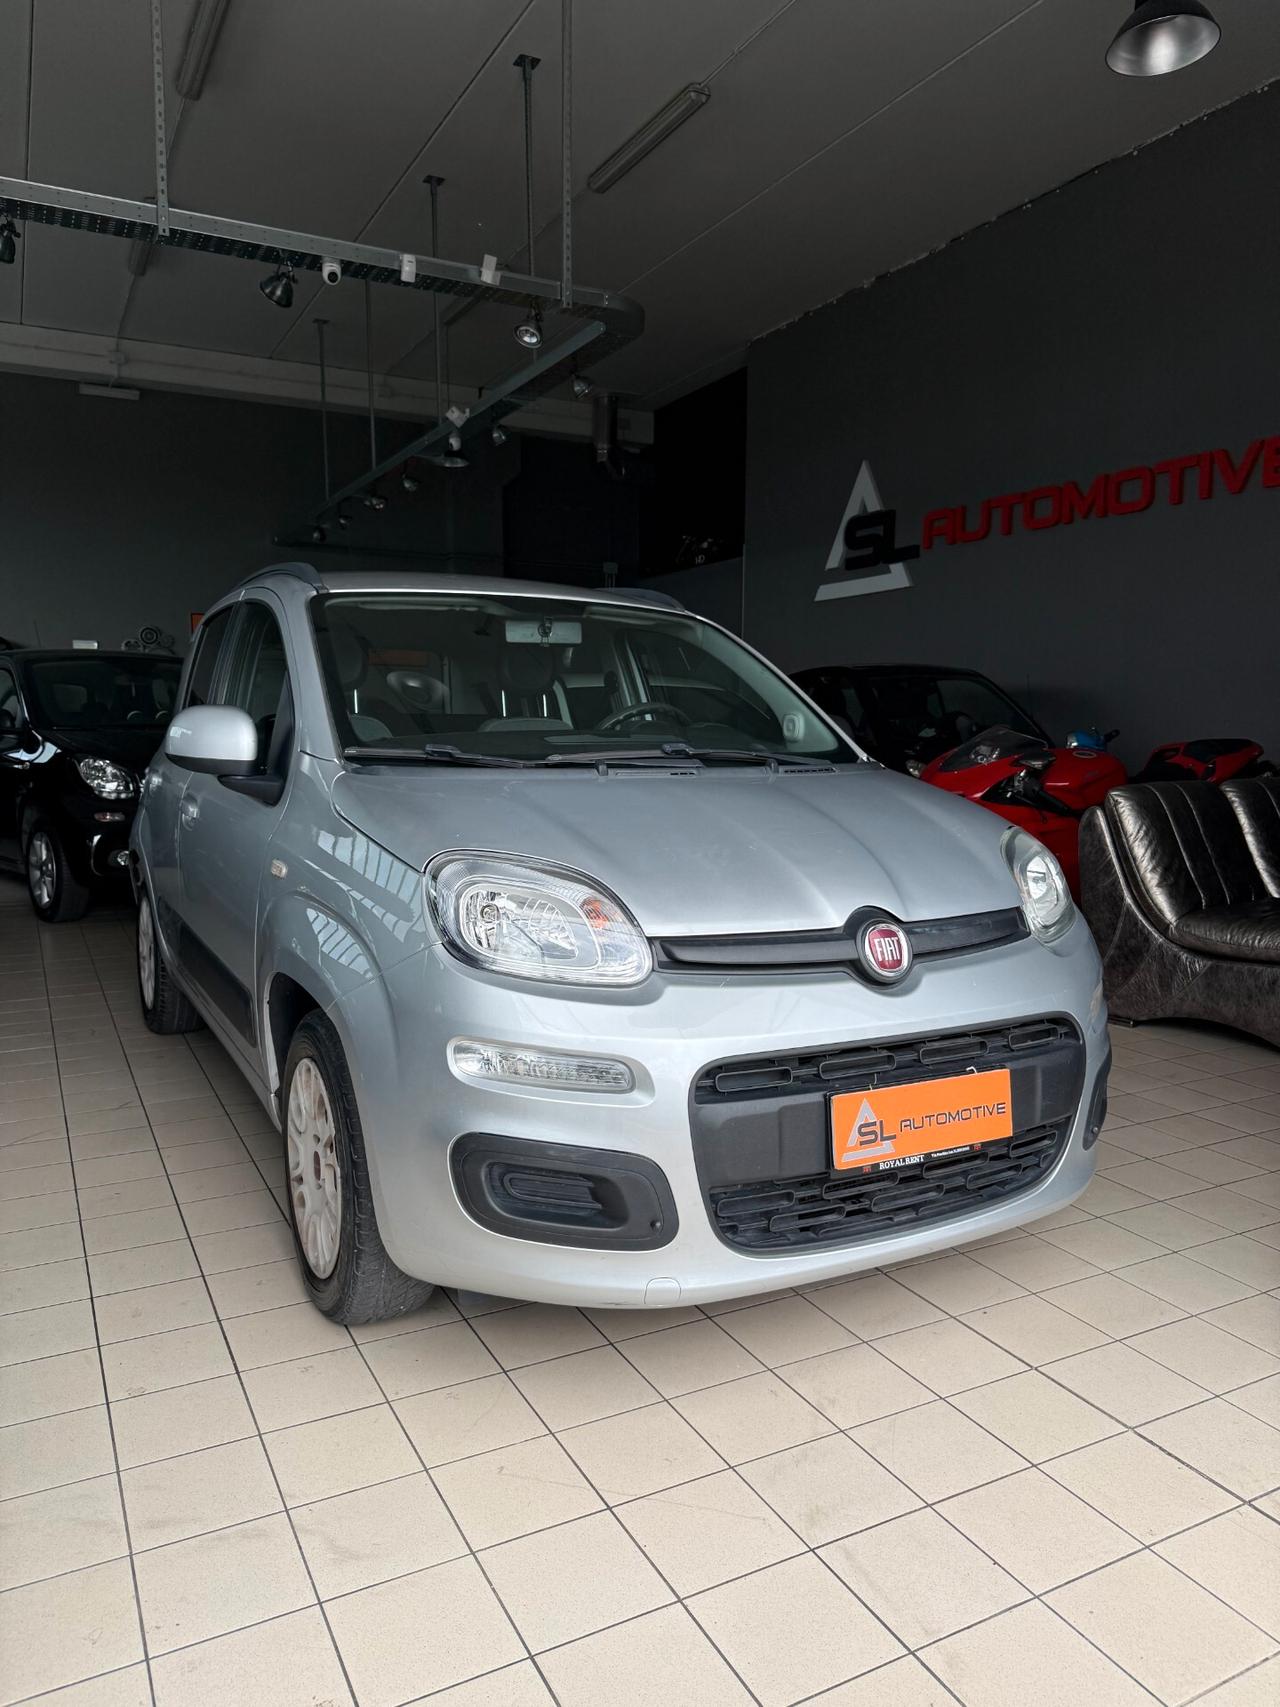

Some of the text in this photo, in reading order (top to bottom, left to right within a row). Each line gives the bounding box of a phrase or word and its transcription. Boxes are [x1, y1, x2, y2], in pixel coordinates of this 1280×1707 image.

[845, 509, 920, 570] SL
[874, 936, 901, 962] FIAT
[858, 1102, 1006, 1146] SL AUTOMOTIVE
